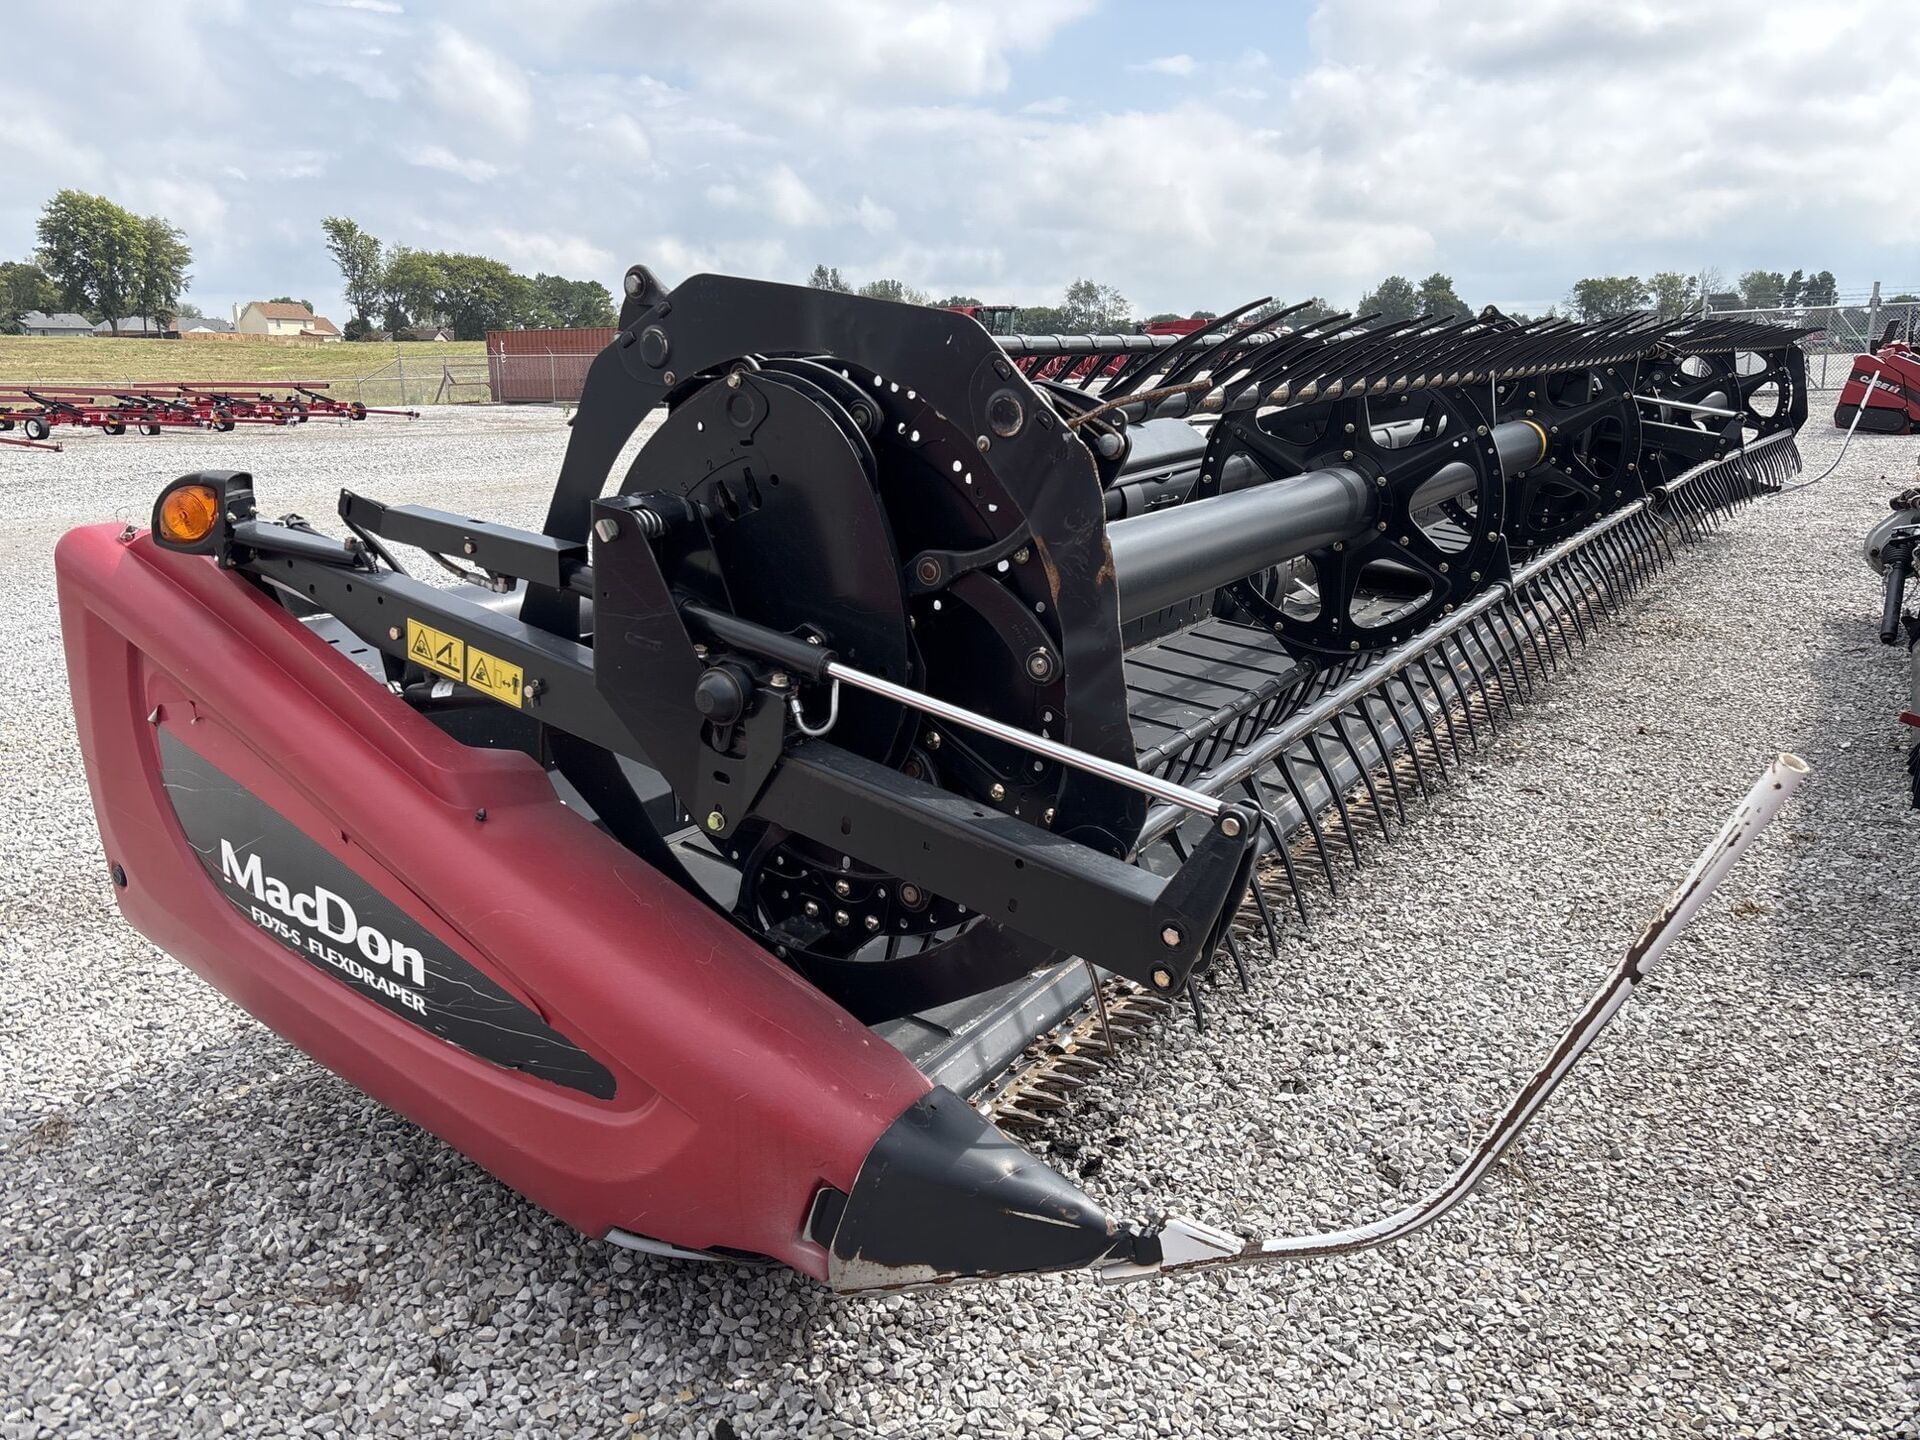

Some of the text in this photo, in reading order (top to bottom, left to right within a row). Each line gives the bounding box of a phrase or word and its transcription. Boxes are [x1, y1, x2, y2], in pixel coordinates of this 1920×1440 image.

[220, 838, 425, 987] MacDon
[250, 905, 428, 1016] FD75-S FLEXDRAPER
